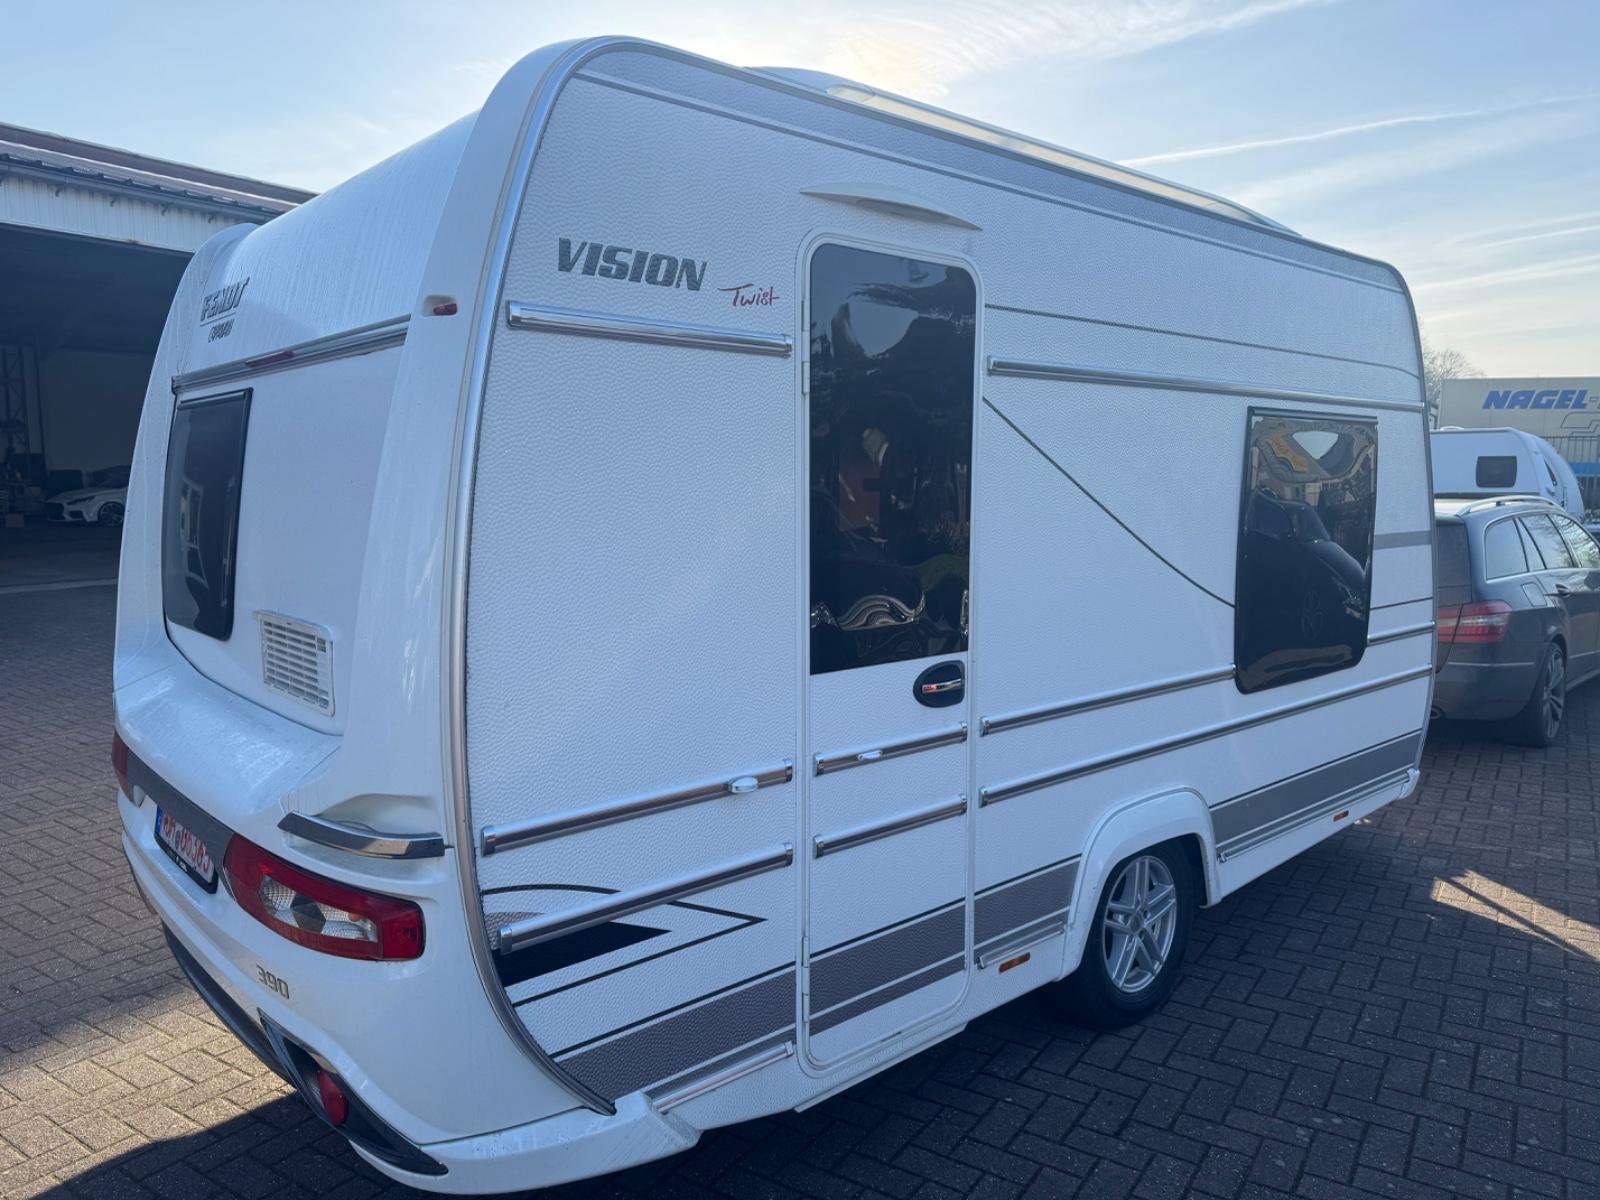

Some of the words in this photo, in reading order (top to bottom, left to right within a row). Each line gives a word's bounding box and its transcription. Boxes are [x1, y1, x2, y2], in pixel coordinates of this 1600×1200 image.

[557, 237, 708, 291] VISION
[717, 283, 780, 306] Twist
[1482, 389, 1600, 411] NAGEL-
[256, 964, 290, 1000] 390
